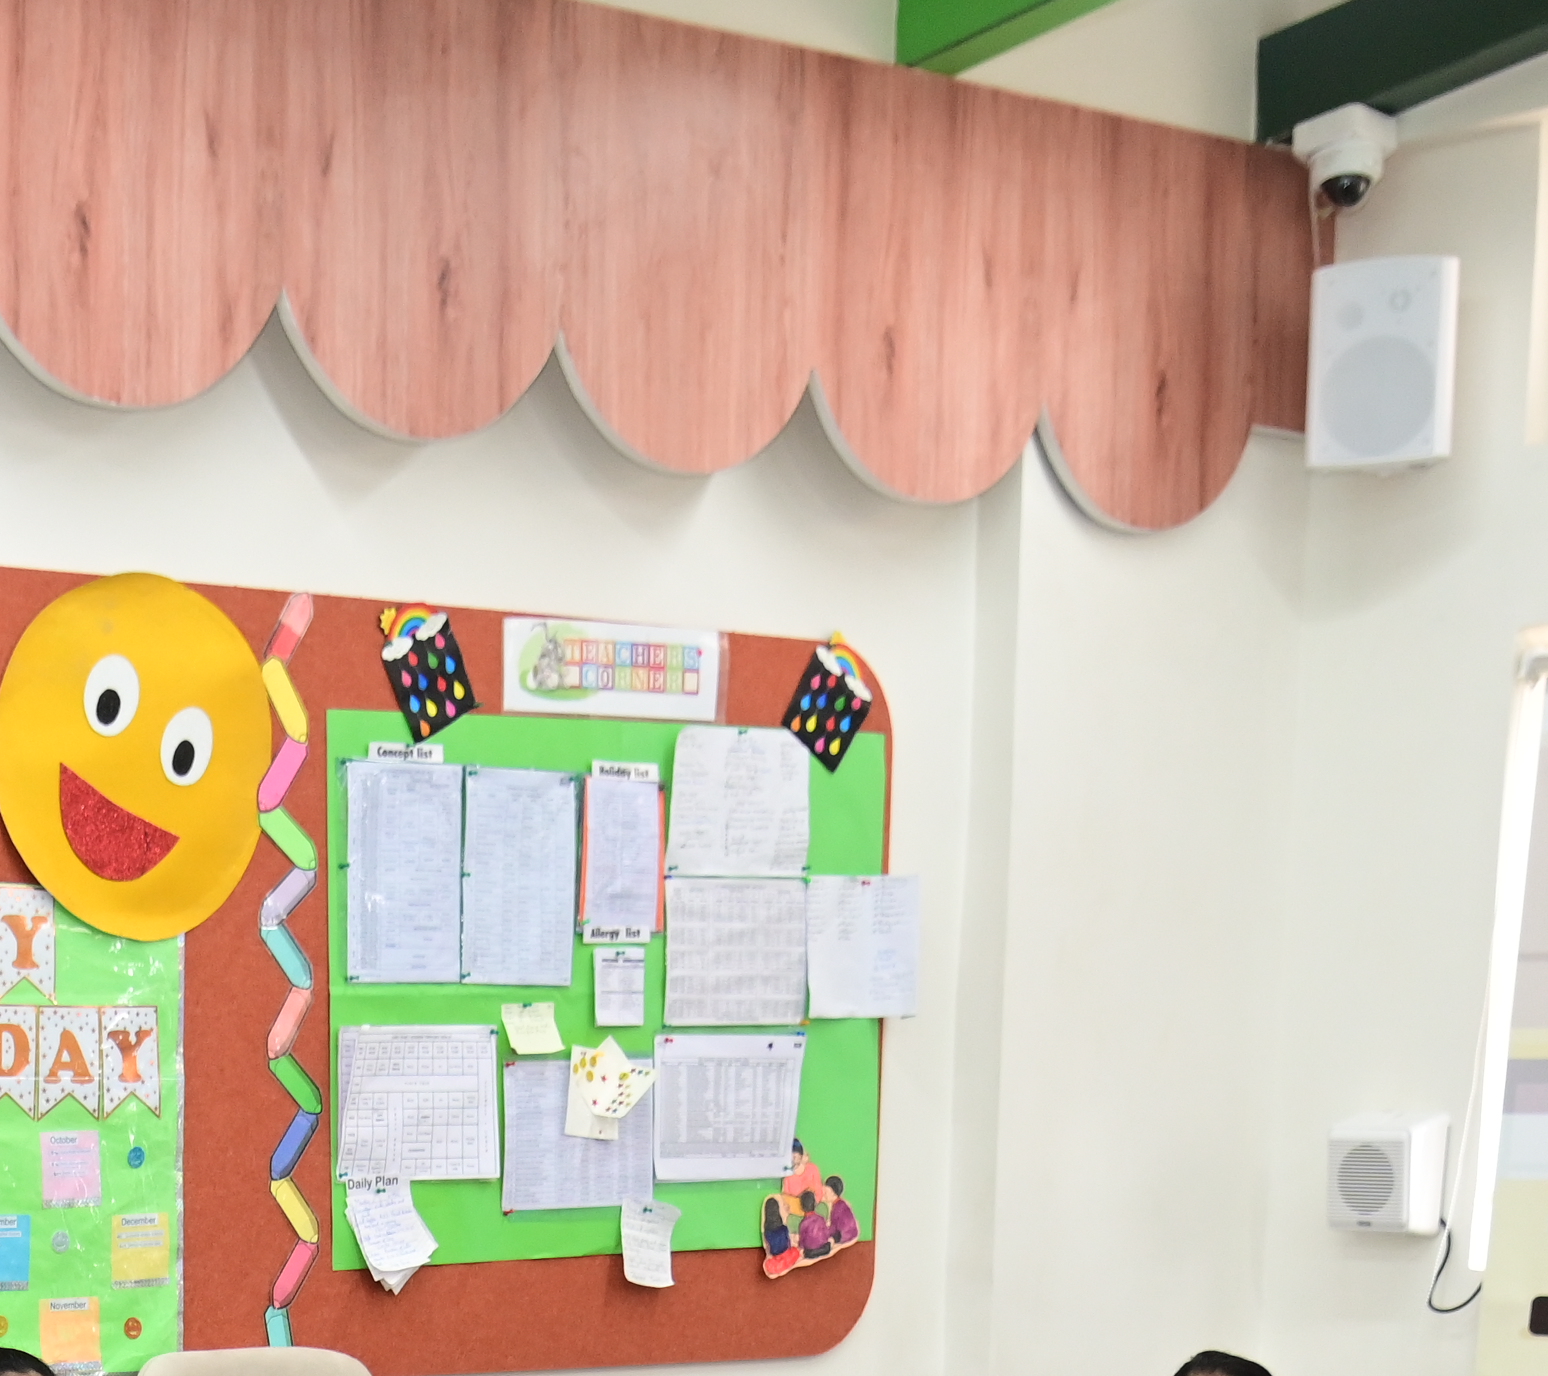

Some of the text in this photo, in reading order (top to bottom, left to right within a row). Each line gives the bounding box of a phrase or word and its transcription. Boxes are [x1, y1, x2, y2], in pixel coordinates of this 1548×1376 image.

[377, 746, 433, 760] Concept list
[599, 766, 649, 780] Holiday list
[590, 928, 641, 941] Allergy list
[50, 1136, 77, 1145] October
[347, 1175, 399, 1191] Daily Plan
[121, 1216, 156, 1227] December
[50, 1300, 87, 1310] November
